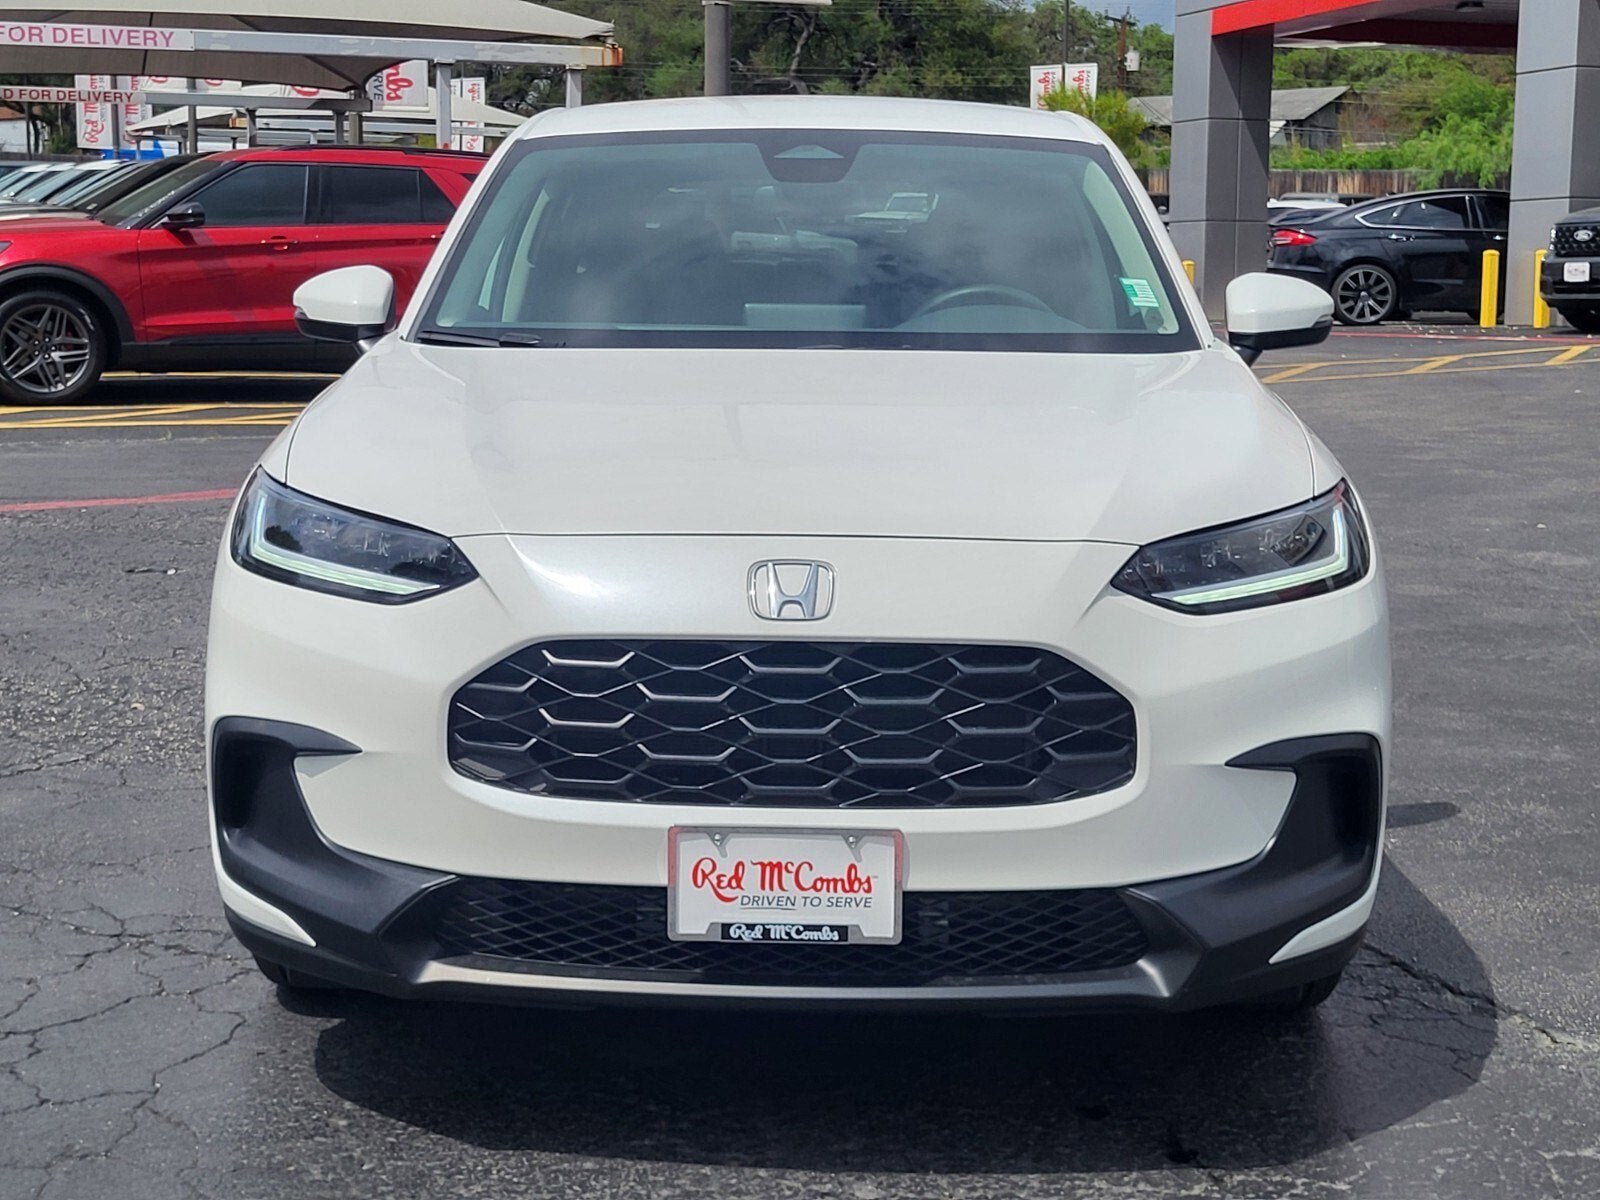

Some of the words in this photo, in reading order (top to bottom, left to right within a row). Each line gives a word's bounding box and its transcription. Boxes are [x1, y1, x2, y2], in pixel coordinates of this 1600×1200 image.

[52, 27, 175, 47] DELIVERY
[19, 89, 51, 101] FOR
[57, 89, 133, 103] DELIVERY
[692, 857, 745, 903] Red
[750, 860, 873, 894] McCombs
[740, 895, 797, 909] DRIVEN
[802, 897, 822, 908] TO
[826, 897, 873, 909] SERVE
[729, 924, 763, 941] Red
[764, 925, 840, 941] McCombs
